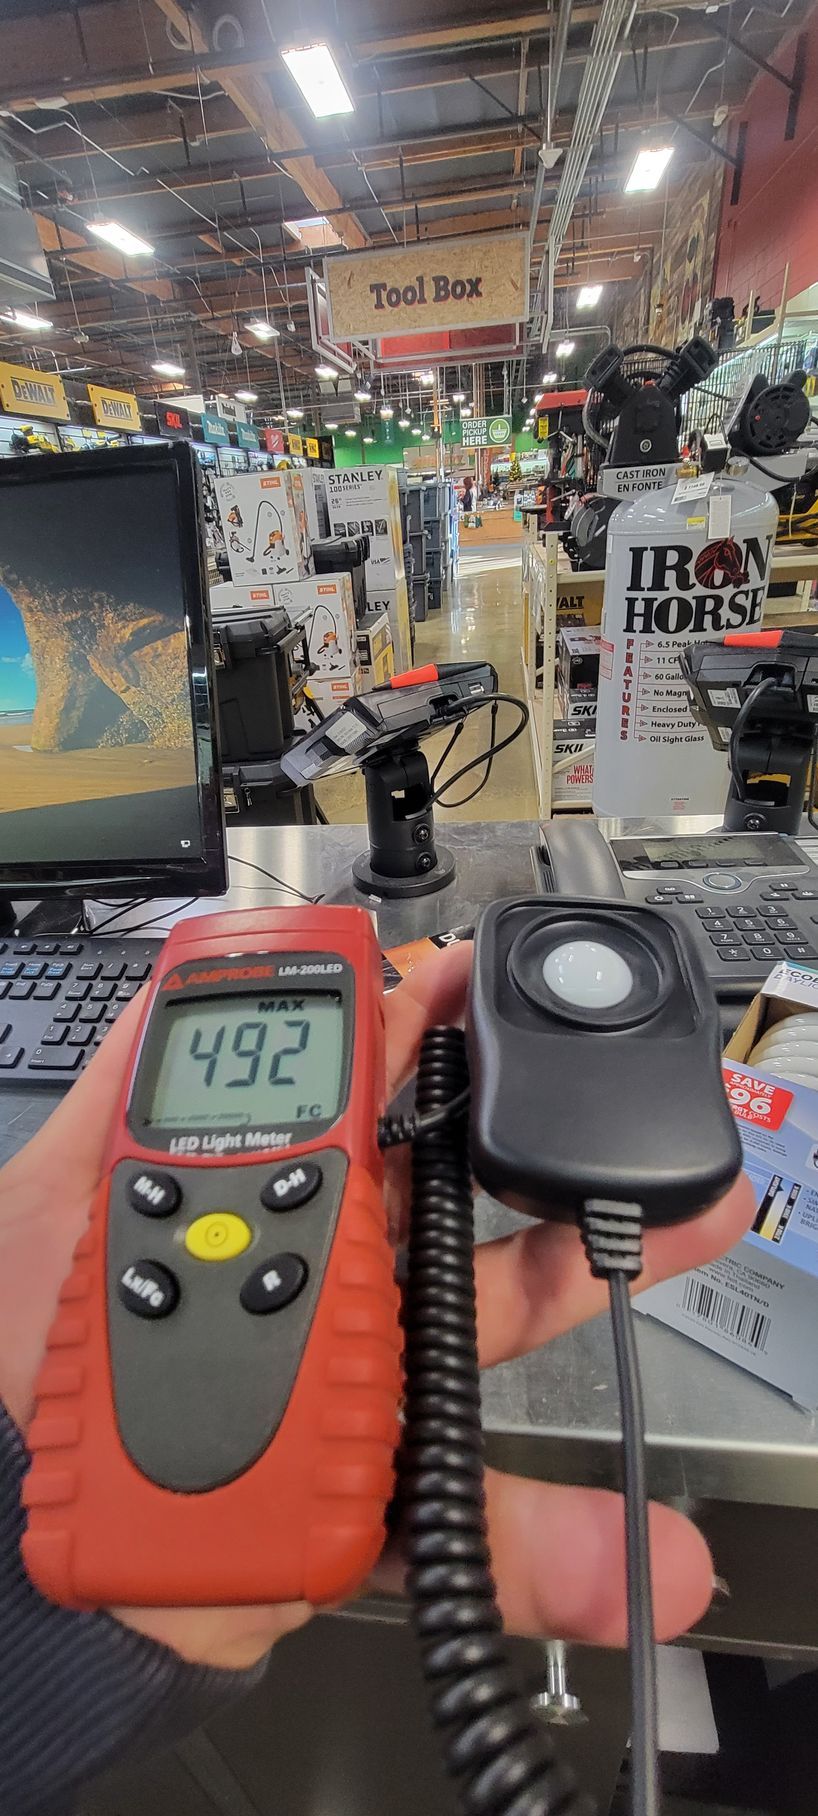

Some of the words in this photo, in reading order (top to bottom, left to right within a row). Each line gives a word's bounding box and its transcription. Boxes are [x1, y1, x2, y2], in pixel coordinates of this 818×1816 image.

[369, 275, 427, 309] Tool
[432, 275, 483, 304] Box
[462, 420, 487, 428] ORDER
[462, 428, 487, 436] PICKUP
[462, 435, 488, 446] HERE
[328, 470, 382, 485] STANLEY
[616, 469, 639, 480] CAST
[642, 468, 666, 479] IRON
[617, 483, 630, 493] EN
[632, 481, 663, 491] FONTE
[626, 534, 773, 592] IRON
[368, 601, 390, 611] LEY
[623, 585, 766, 634] HORSE
[620, 638, 634, 741] FEATURES
[666, 690, 687, 698] Magn
[571, 705, 597, 716] SKI
[652, 705, 688, 713] Enclosed
[651, 721, 676, 729] Heavy
[680, 721, 696, 729] Duty
[649, 735, 661, 743] Oil
[662, 735, 683, 744] Sight
[685, 735, 704, 743] Glass
[567, 775, 593, 784] POWERS
[278, 963, 343, 977] LM-200LED
[258, 1000, 305, 1013] MAX
[190, 1019, 310, 1087] 492
[730, 1073, 775, 1096] SAVE
[296, 1103, 322, 1119] FC
[170, 1136, 199, 1150] LED
[202, 1133, 242, 1151] Light
[245, 1132, 292, 1147] Meter
[273, 1168, 306, 1197] D-H
[133, 1175, 166, 1205] M-H
[724, 1256, 741, 1268] TRIC
[744, 1266, 785, 1289] COMPANY
[262, 1270, 282, 1292] R
